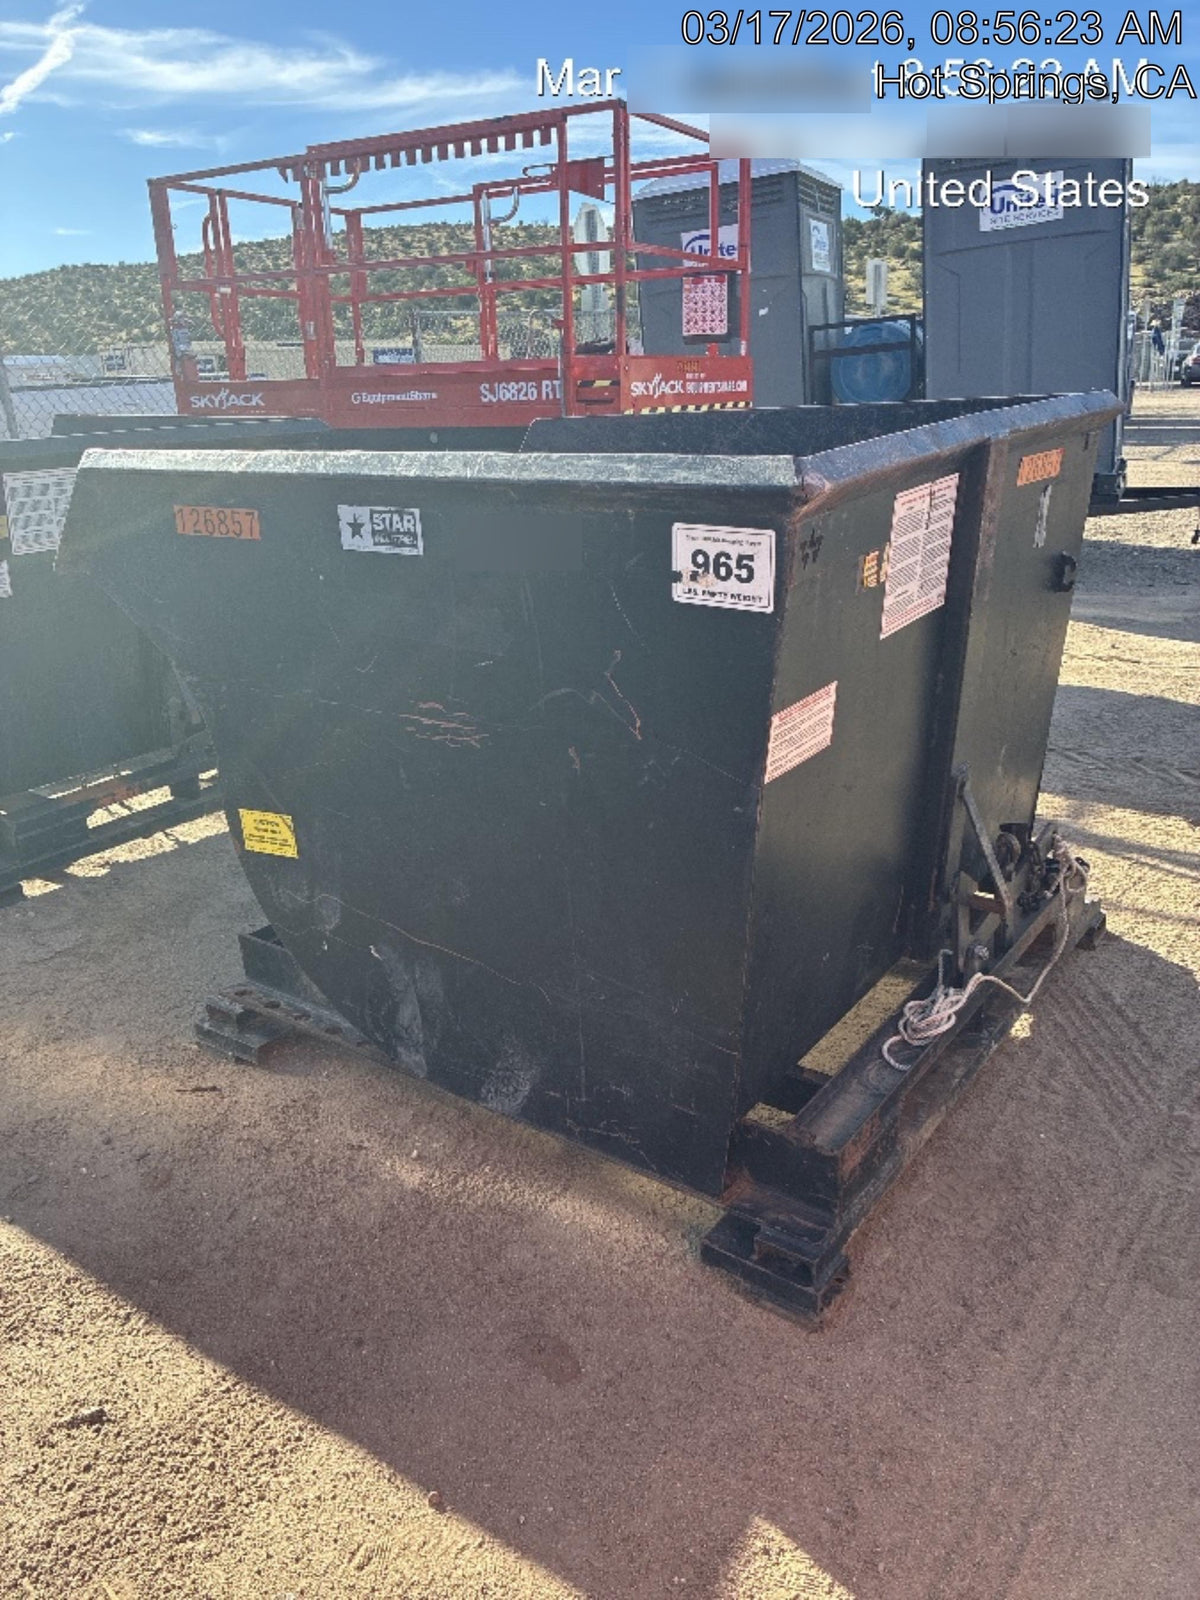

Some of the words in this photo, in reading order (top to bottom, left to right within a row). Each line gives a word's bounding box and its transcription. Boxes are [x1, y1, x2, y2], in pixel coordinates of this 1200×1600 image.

[480, 381, 538, 402] SJ6826
[630, 372, 684, 399] SKYJACK
[190, 387, 266, 410] SKYJACK
[176, 508, 255, 538] 126857
[373, 512, 415, 533] STAR
[691, 548, 755, 584] 965
